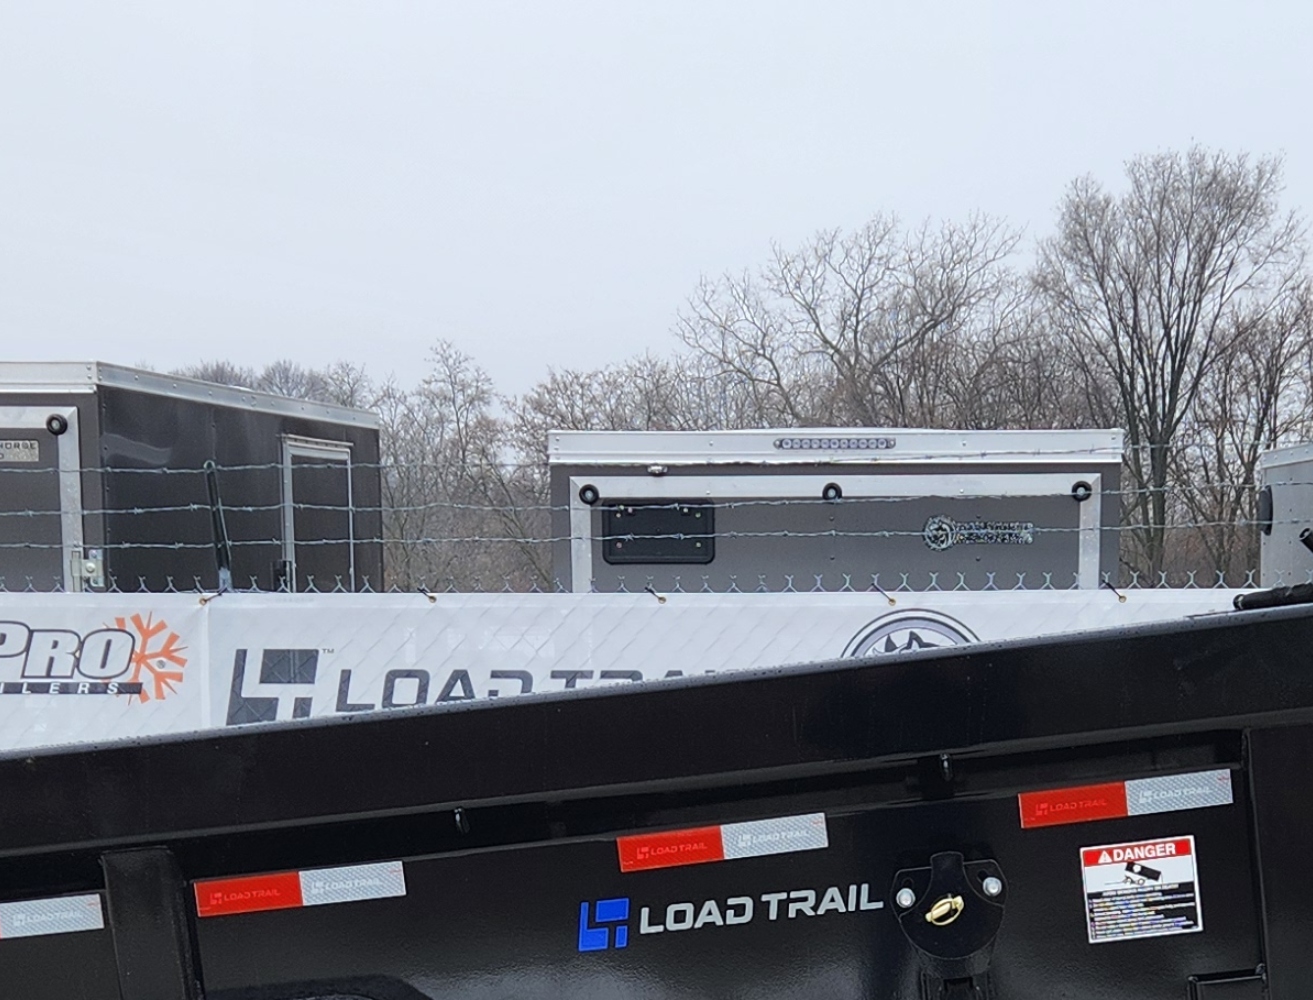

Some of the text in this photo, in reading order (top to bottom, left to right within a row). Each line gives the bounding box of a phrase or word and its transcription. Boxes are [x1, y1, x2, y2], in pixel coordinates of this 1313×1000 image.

[334, 668, 534, 713] LOAD
[1112, 842, 1177, 862] DANGER
[639, 883, 884, 934] LOAD TRAIL
